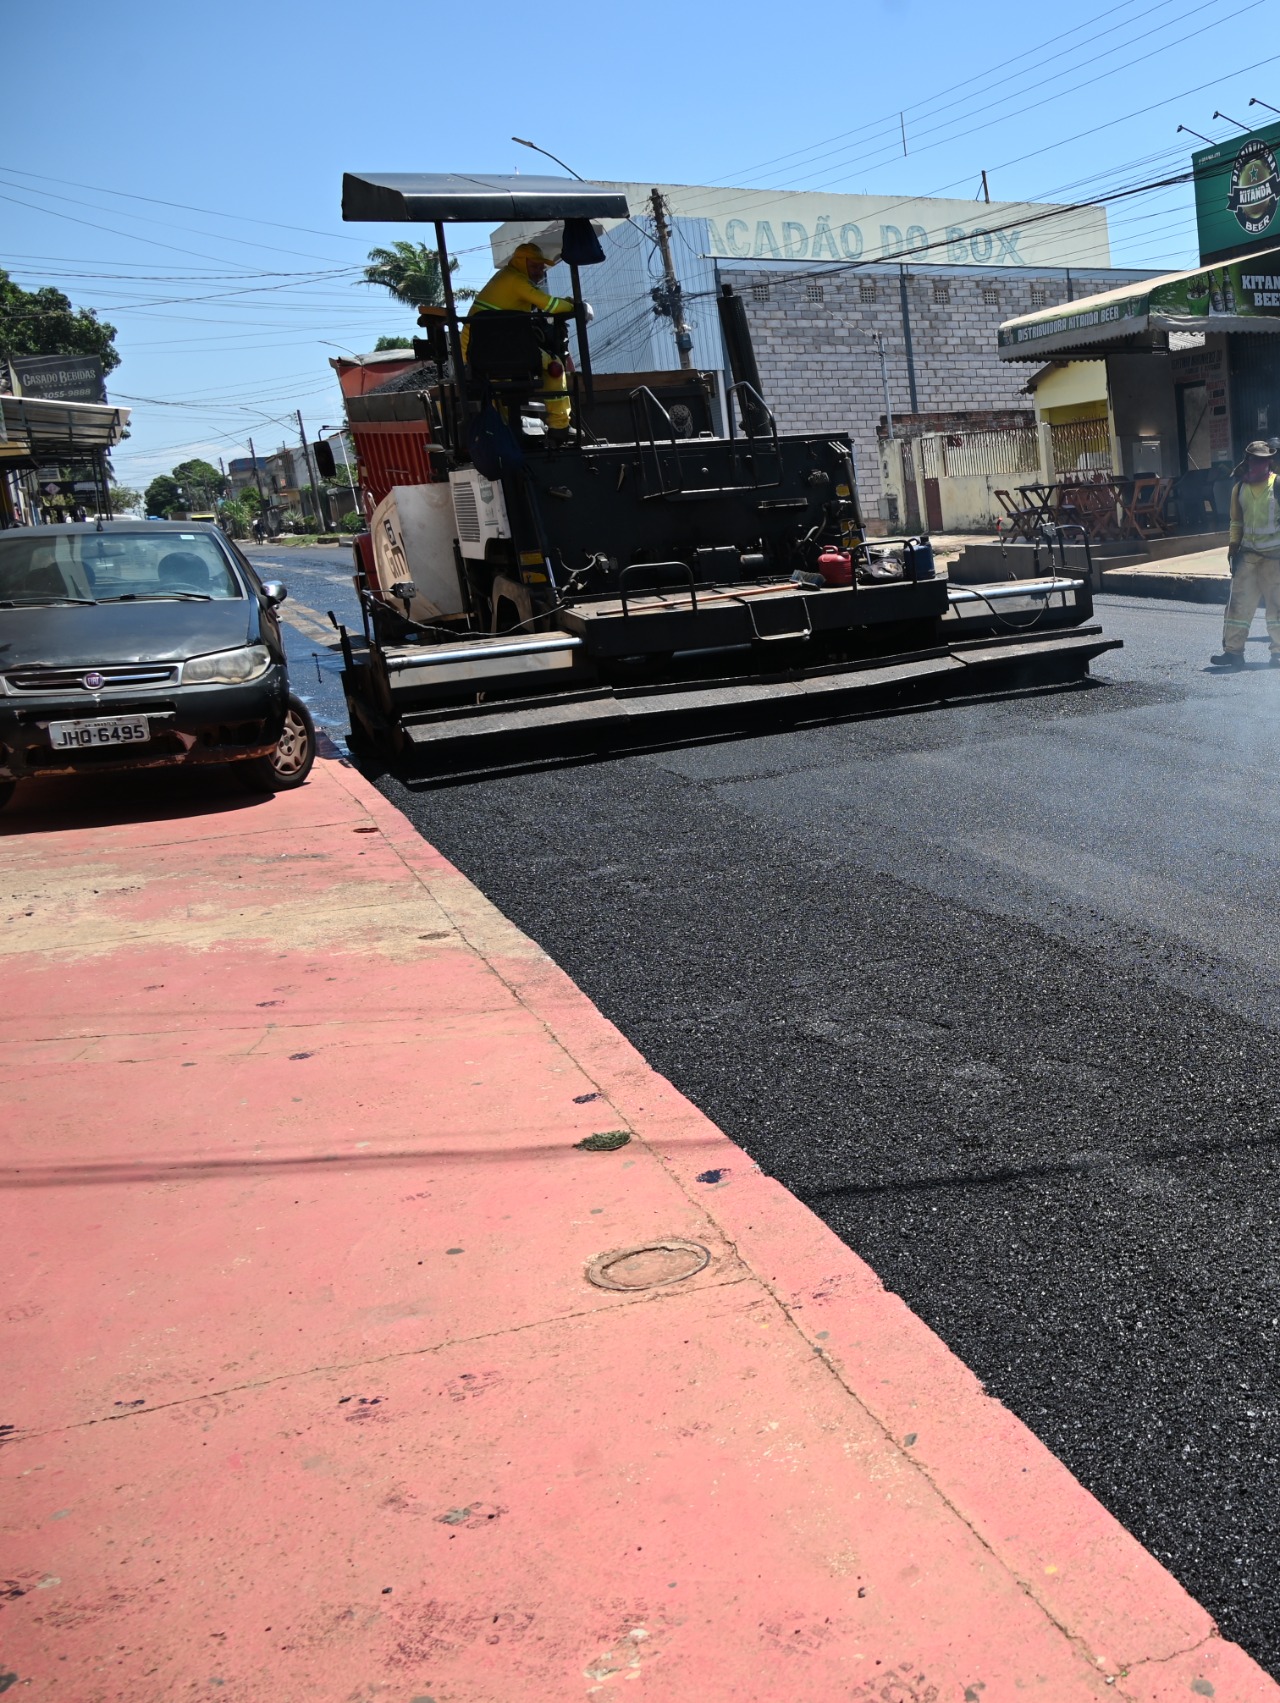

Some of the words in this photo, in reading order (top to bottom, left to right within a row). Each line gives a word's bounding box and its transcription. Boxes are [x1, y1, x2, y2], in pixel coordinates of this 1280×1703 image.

[1239, 182, 1272, 203] KITANDA
[1245, 214, 1270, 232] BEER
[879, 224, 929, 262] DO
[946, 226, 1025, 266] BOX
[1069, 311, 1098, 330] KITANDA
[1101, 306, 1119, 322] BEER
[59, 369, 96, 384] BEBIDAS
[87, 676, 100, 686] FIAT
